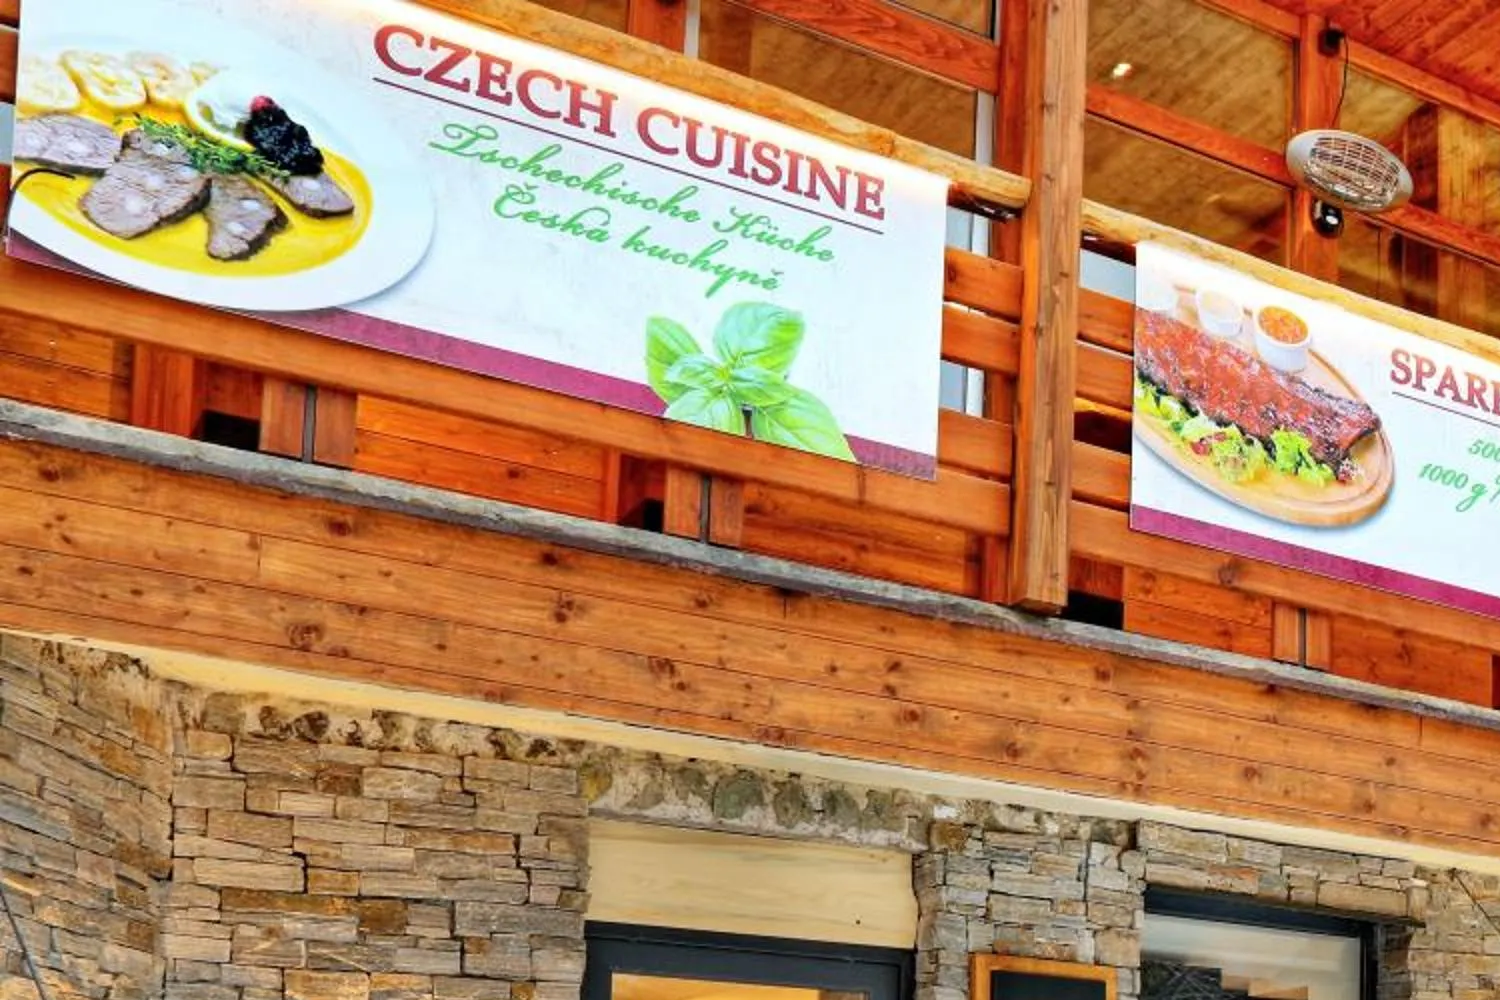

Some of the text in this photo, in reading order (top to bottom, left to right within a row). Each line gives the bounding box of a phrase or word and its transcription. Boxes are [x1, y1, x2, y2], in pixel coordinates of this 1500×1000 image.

[372, 23, 886, 221] CZECH CUISINE
[429, 122, 836, 263] Tschechische Küche
[622, 225, 784, 299] kuchyně
[1419, 463, 1468, 490] 1000
